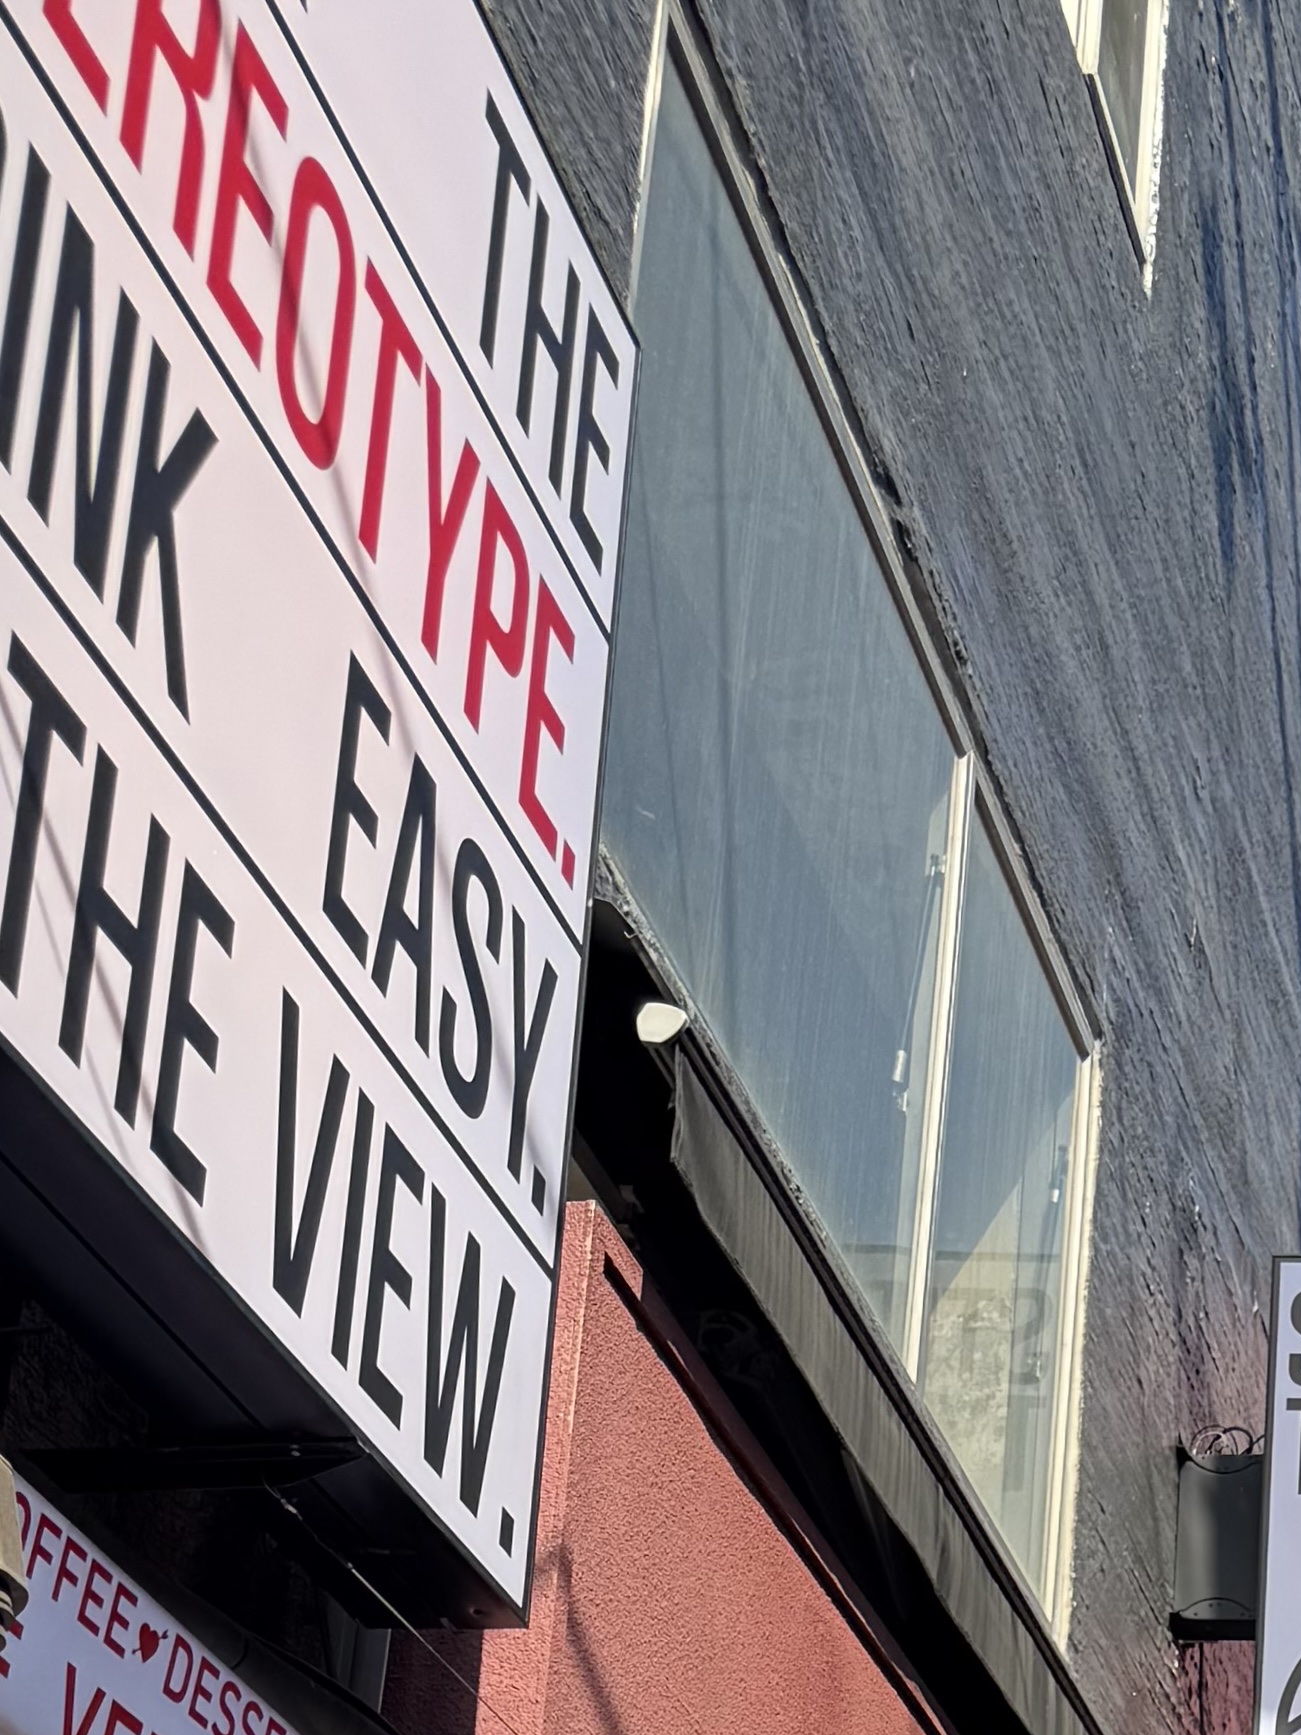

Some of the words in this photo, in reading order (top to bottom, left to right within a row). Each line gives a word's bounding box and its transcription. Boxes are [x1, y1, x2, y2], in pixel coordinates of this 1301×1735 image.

[0, 100, 218, 725] INK
[479, 87, 620, 576] THE
[0, 630, 235, 1208] THE
[322, 650, 558, 1218] EASY.
[272, 985, 515, 1558] VIEW.
